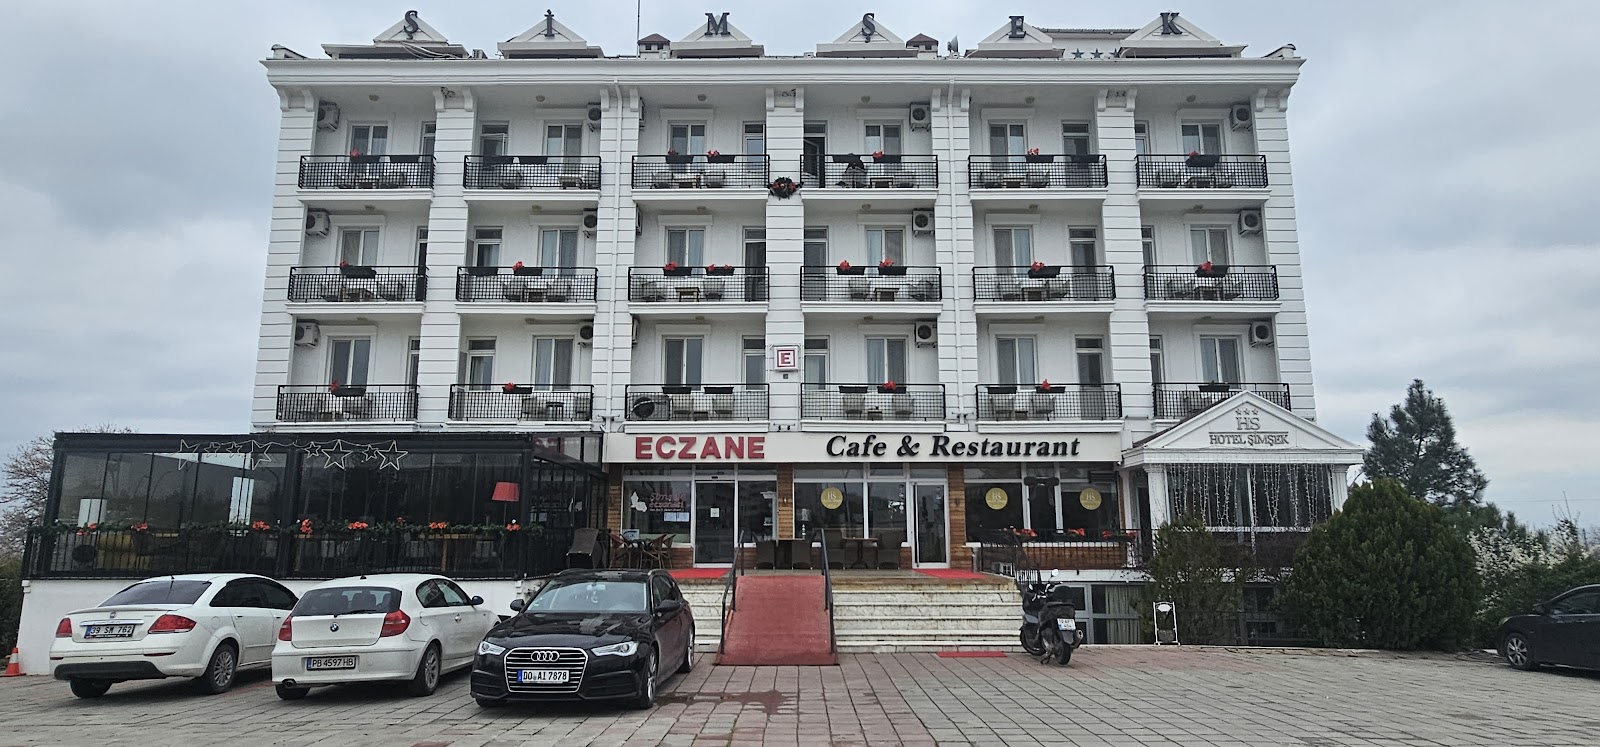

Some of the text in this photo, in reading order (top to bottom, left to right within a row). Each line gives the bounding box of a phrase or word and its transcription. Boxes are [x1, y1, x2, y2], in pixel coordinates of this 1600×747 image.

[704, 12, 730, 36] M
[1008, 15, 1026, 39] E
[1159, 12, 1182, 35] K
[780, 352, 791, 365] E
[1235, 417, 1260, 431] HS
[826, 434, 1081, 458] Cafe & Restaurant
[1209, 434, 1246, 445] HOTEL
[635, 436, 766, 460] ECZANE
[323, 659, 342, 667] 4597
[343, 658, 353, 666] HB
[548, 671, 567, 680] 7878
